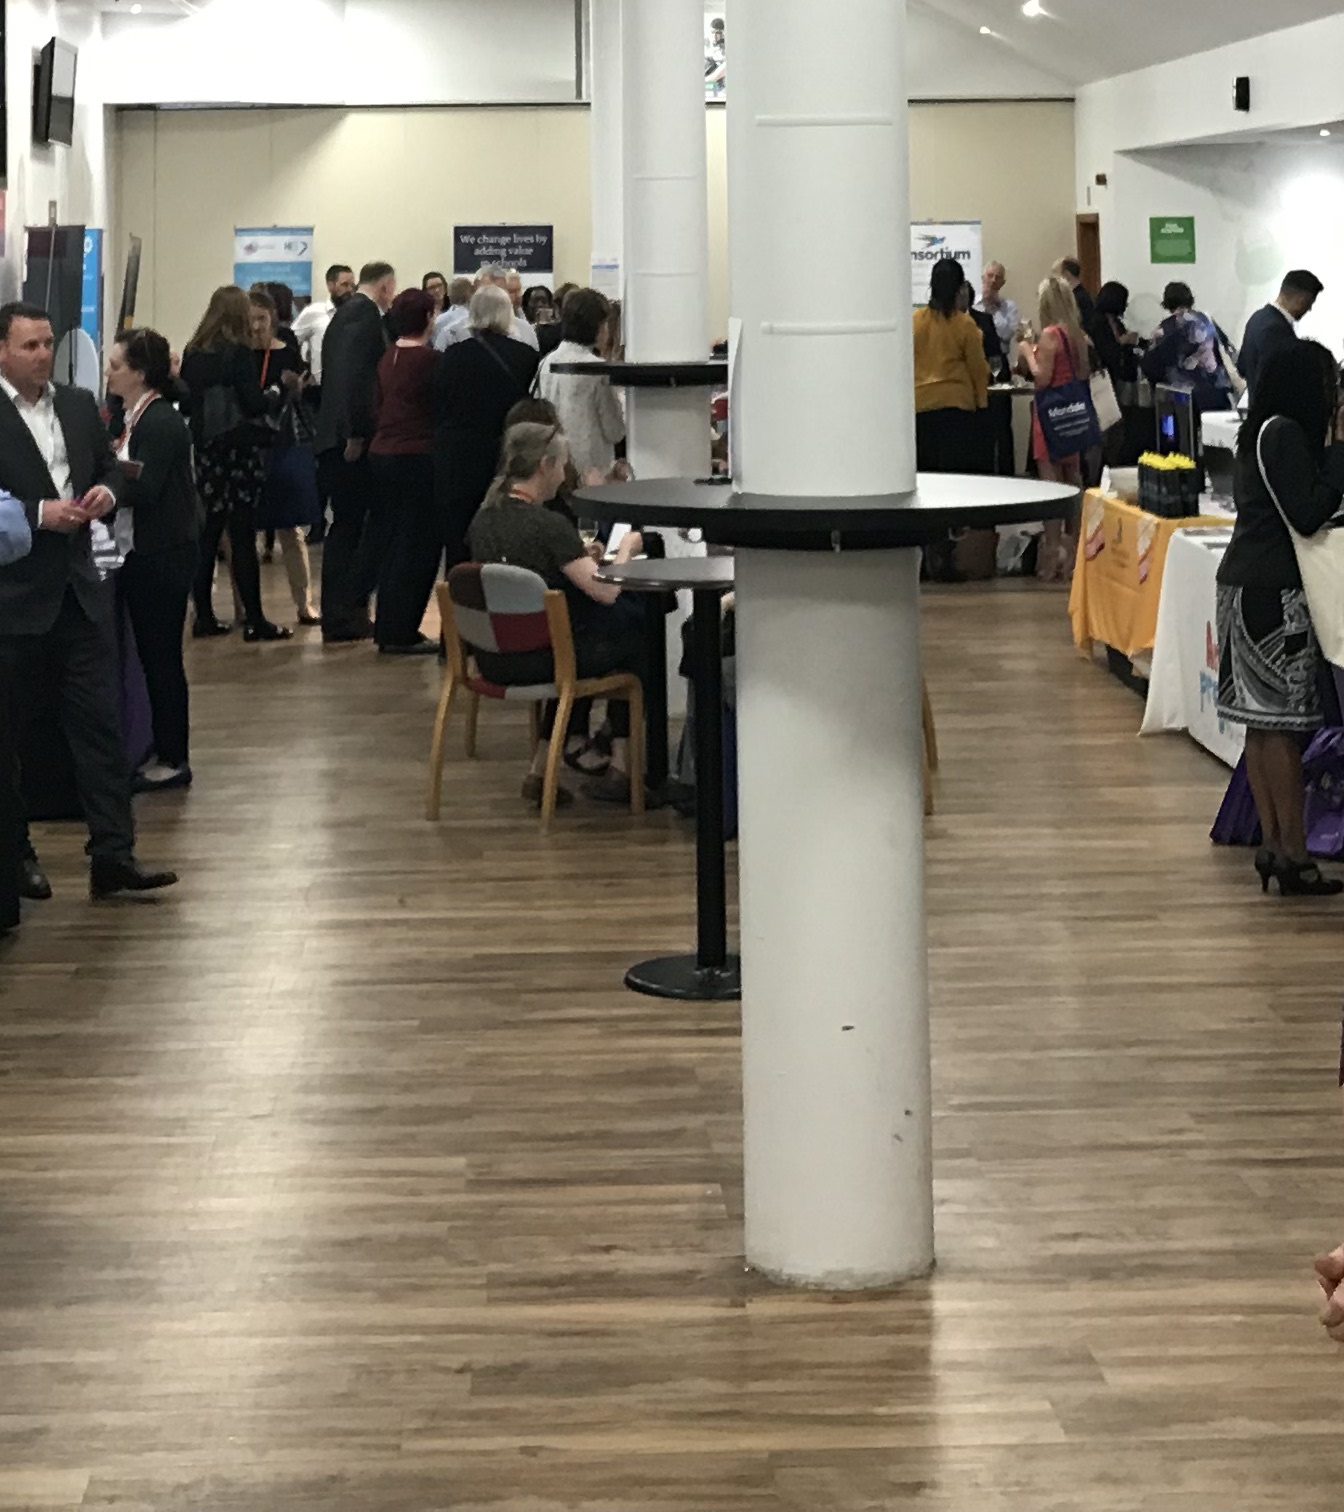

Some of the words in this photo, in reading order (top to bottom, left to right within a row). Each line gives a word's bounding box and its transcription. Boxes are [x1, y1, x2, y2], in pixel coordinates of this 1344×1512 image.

[460, 234, 475, 245] We
[477, 234, 512, 246] change
[513, 233, 534, 244] lives
[536, 234, 548, 246] by
[474, 245, 507, 258] adding
[508, 245, 534, 255] value
[910, 246, 971, 261] nsortium
